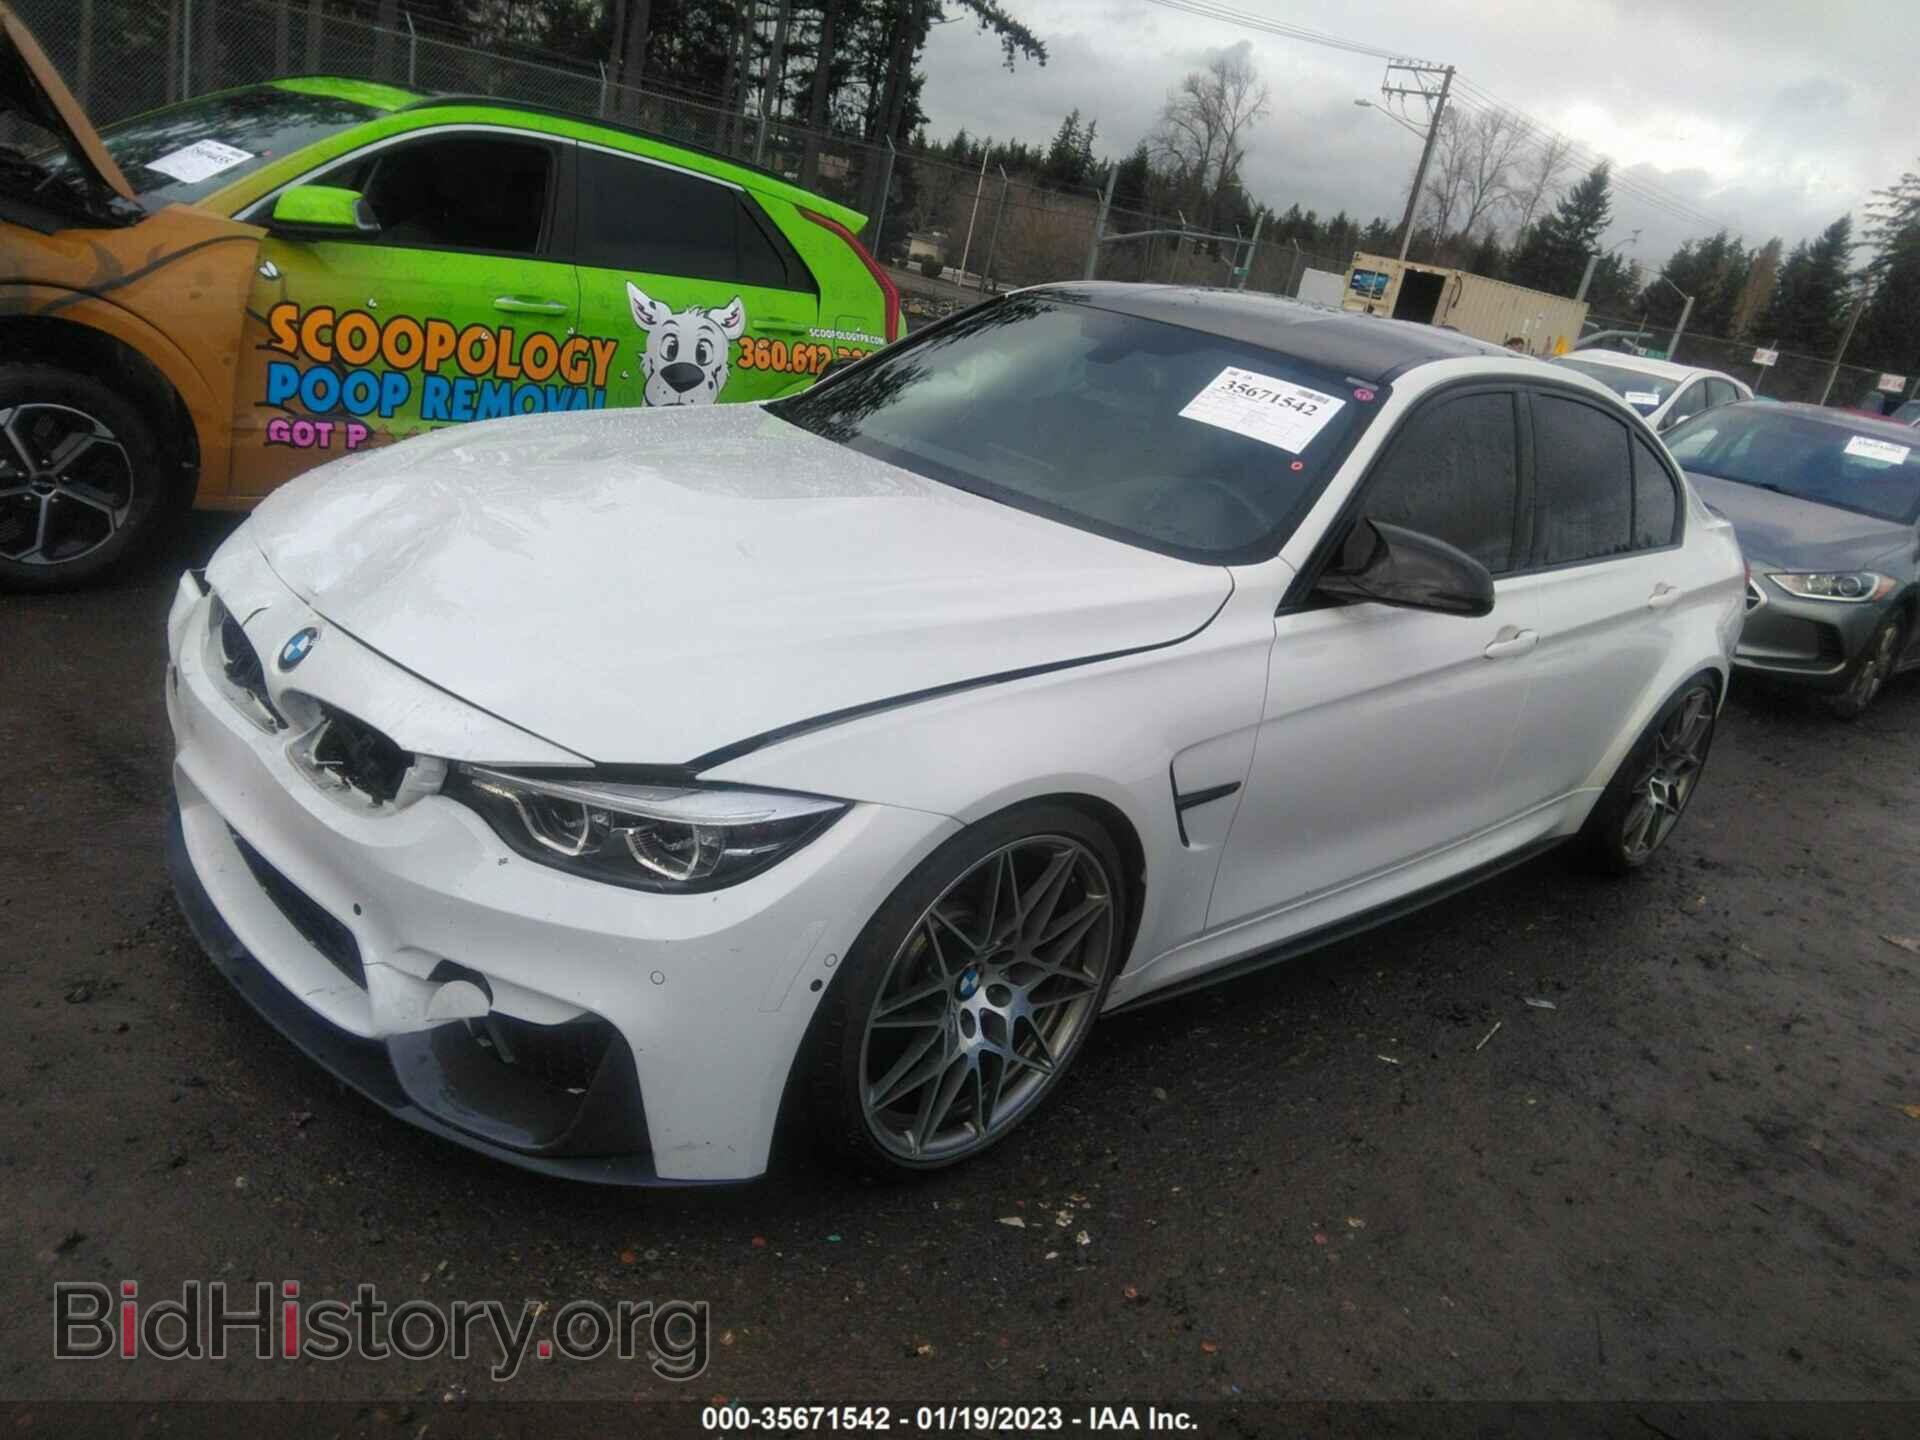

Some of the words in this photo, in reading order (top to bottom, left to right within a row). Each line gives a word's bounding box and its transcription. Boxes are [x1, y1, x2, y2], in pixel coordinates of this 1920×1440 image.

[268, 302, 618, 387] SCOOPOLOGY
[267, 362, 409, 418] POOP
[1221, 380, 1319, 417] 35671542
[268, 418, 335, 449] GOT
